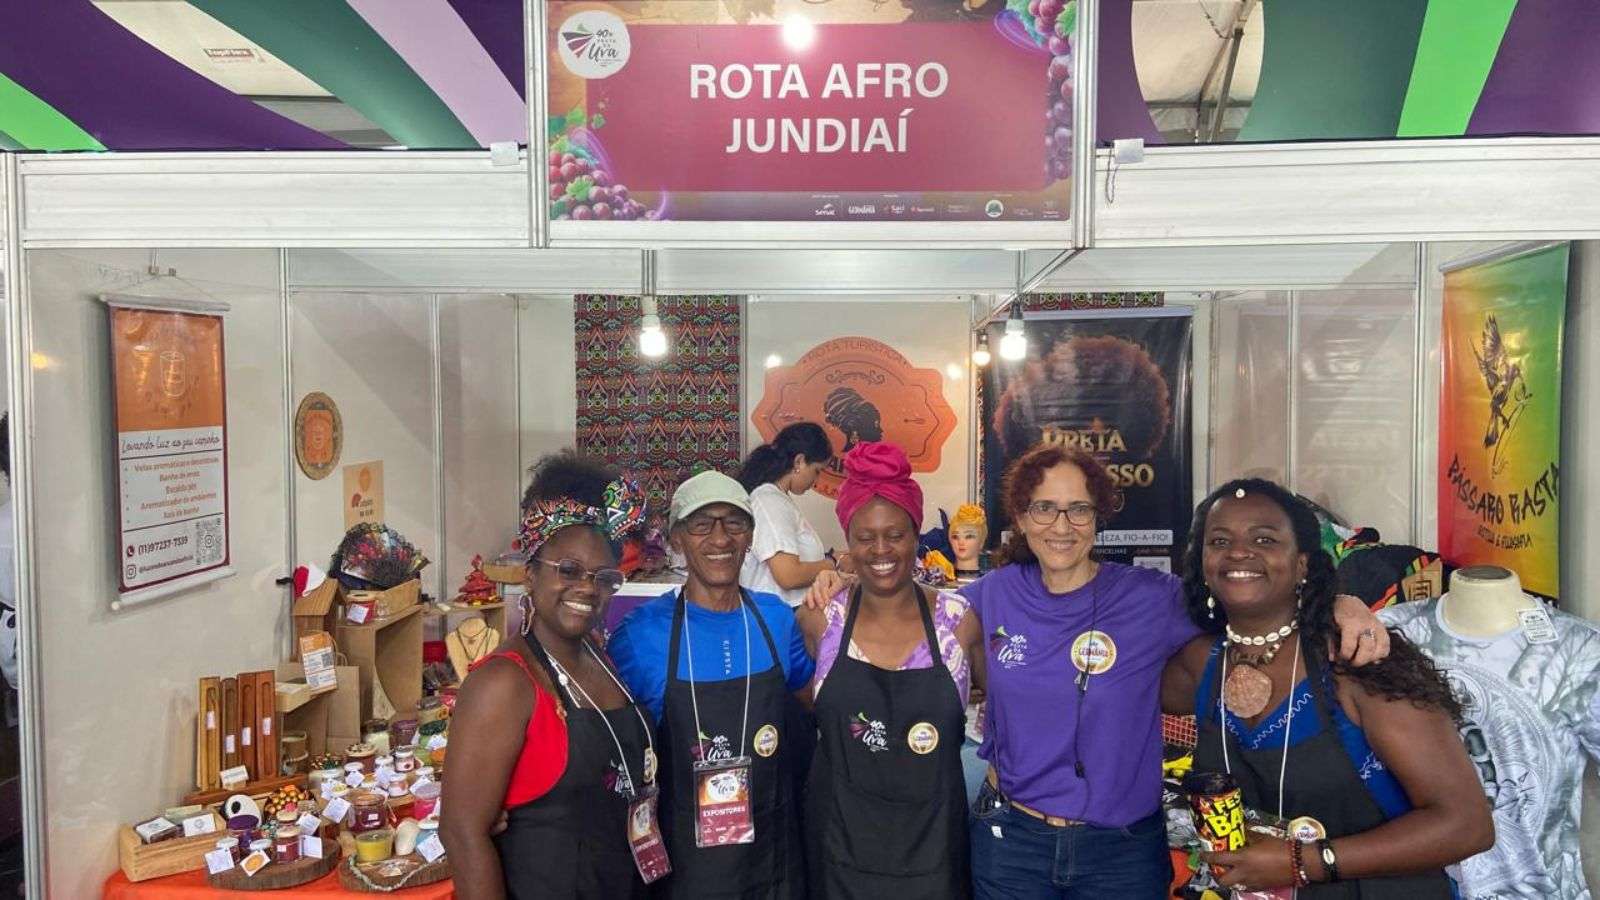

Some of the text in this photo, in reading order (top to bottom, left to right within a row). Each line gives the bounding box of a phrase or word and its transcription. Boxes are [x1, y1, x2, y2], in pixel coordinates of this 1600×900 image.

[588, 42, 617, 62] Uva
[690, 62, 949, 99] ROTA AFRO
[725, 108, 914, 153] JUNDIAÍ
[1509, 461, 1560, 525] RASTA
[997, 644, 1025, 663] Uva
[862, 730, 887, 746] Uva
[707, 747, 732, 762] Uva
[703, 805, 746, 817] EXPOSITORES
